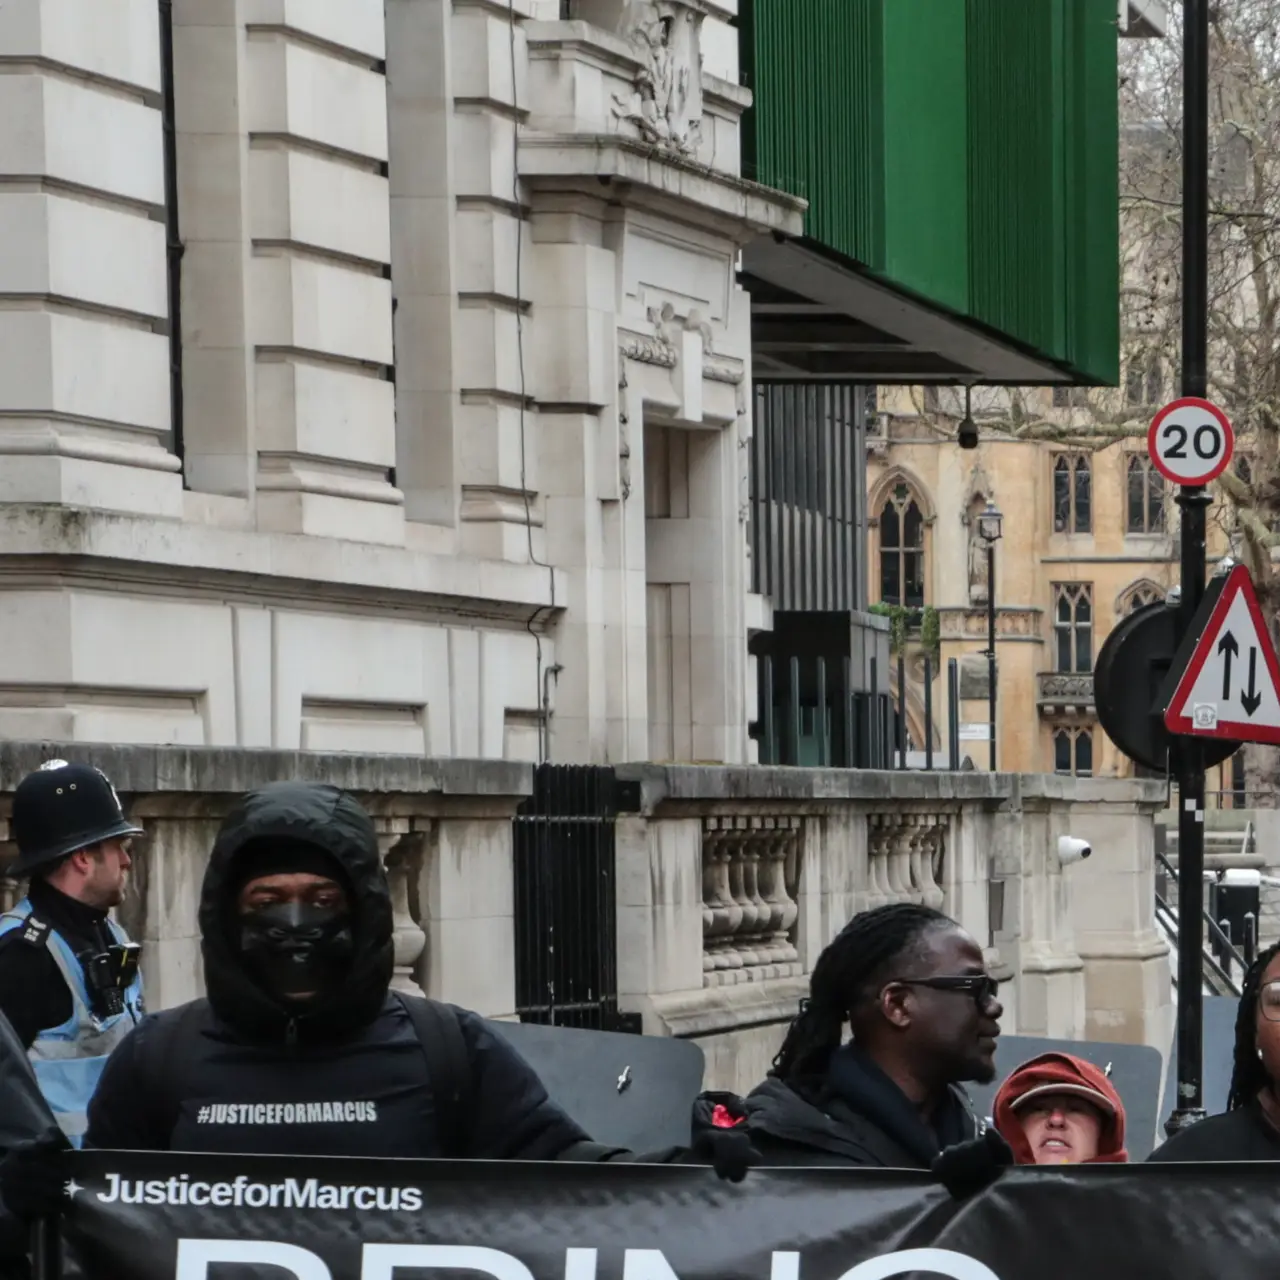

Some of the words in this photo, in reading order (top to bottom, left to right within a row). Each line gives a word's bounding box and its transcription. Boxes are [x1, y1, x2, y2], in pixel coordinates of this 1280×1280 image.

[1162, 423, 1222, 460] 20
[197, 1101, 378, 1125] #JUSTICEFORMARCUS
[97, 1173, 423, 1212] JusticeforMarcus
